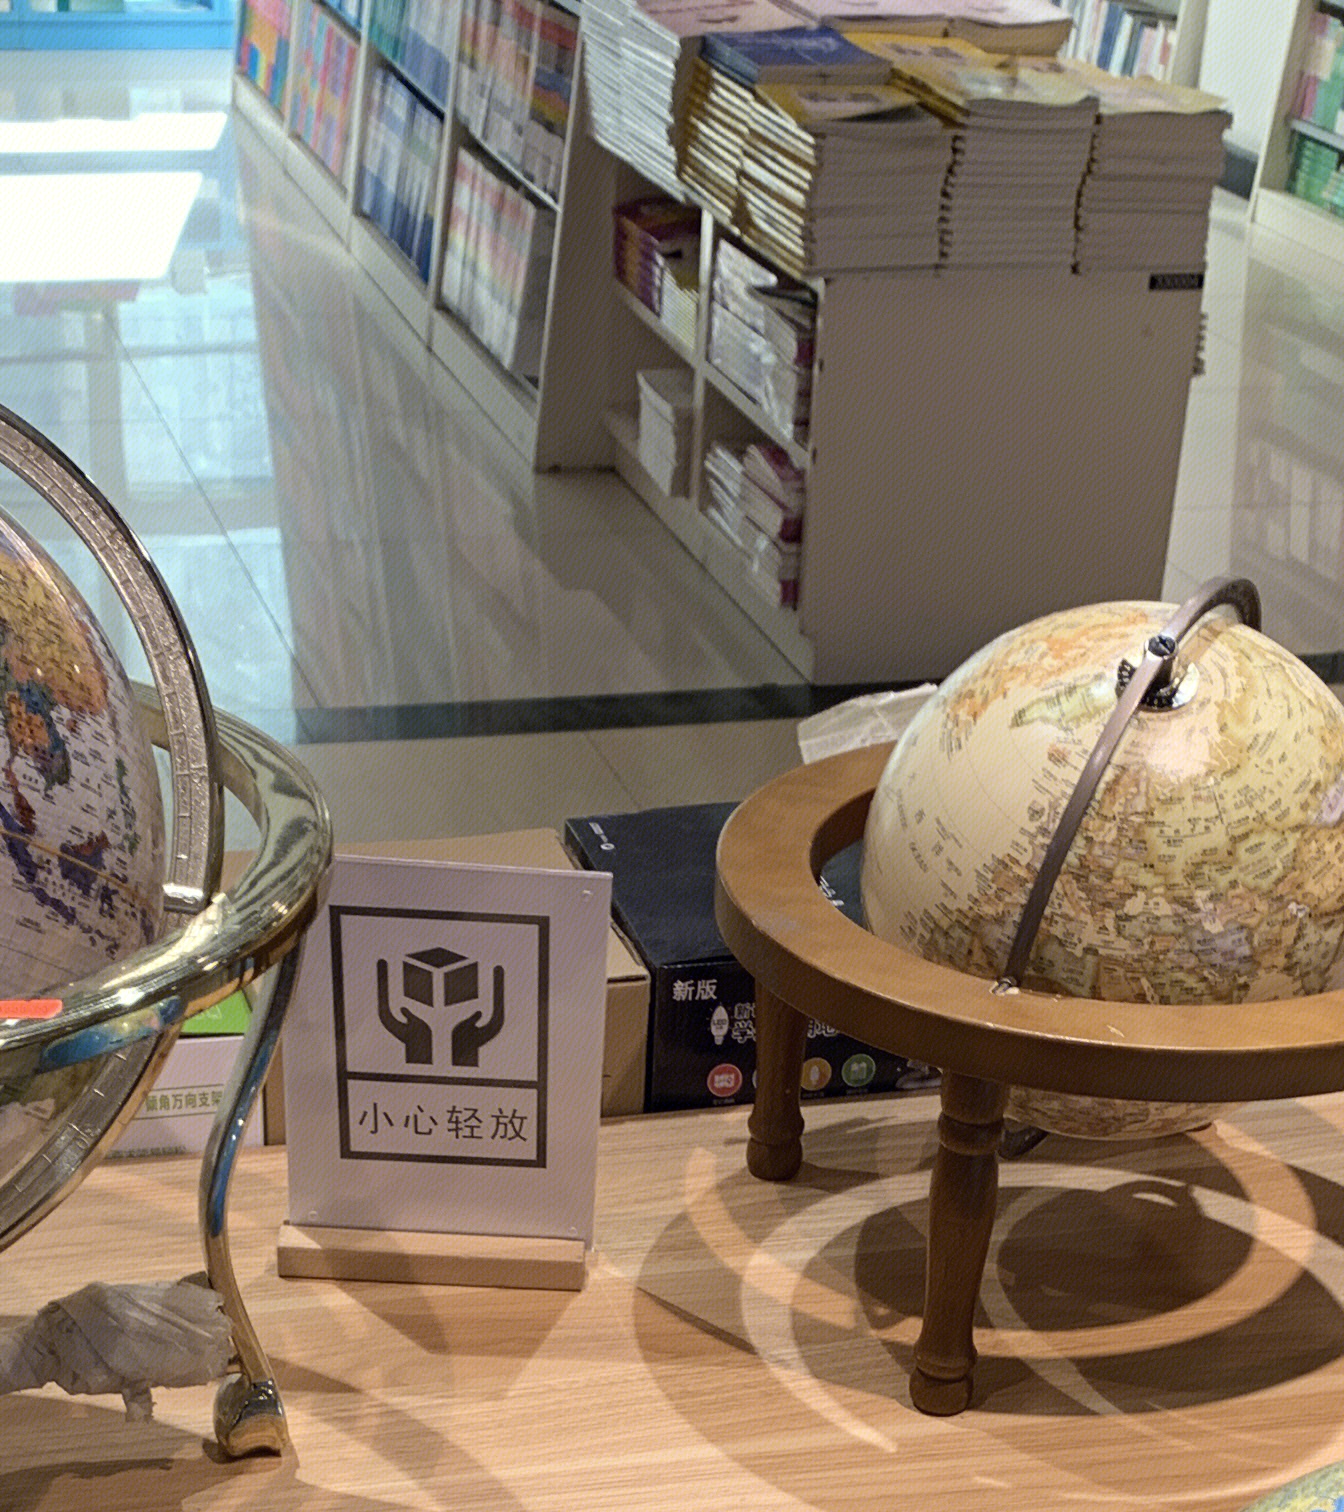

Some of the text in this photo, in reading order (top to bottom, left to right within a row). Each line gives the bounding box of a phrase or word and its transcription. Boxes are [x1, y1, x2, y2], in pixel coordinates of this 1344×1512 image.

[672, 979, 717, 1001] 新版
[358, 1102, 529, 1143] 小心轻放
